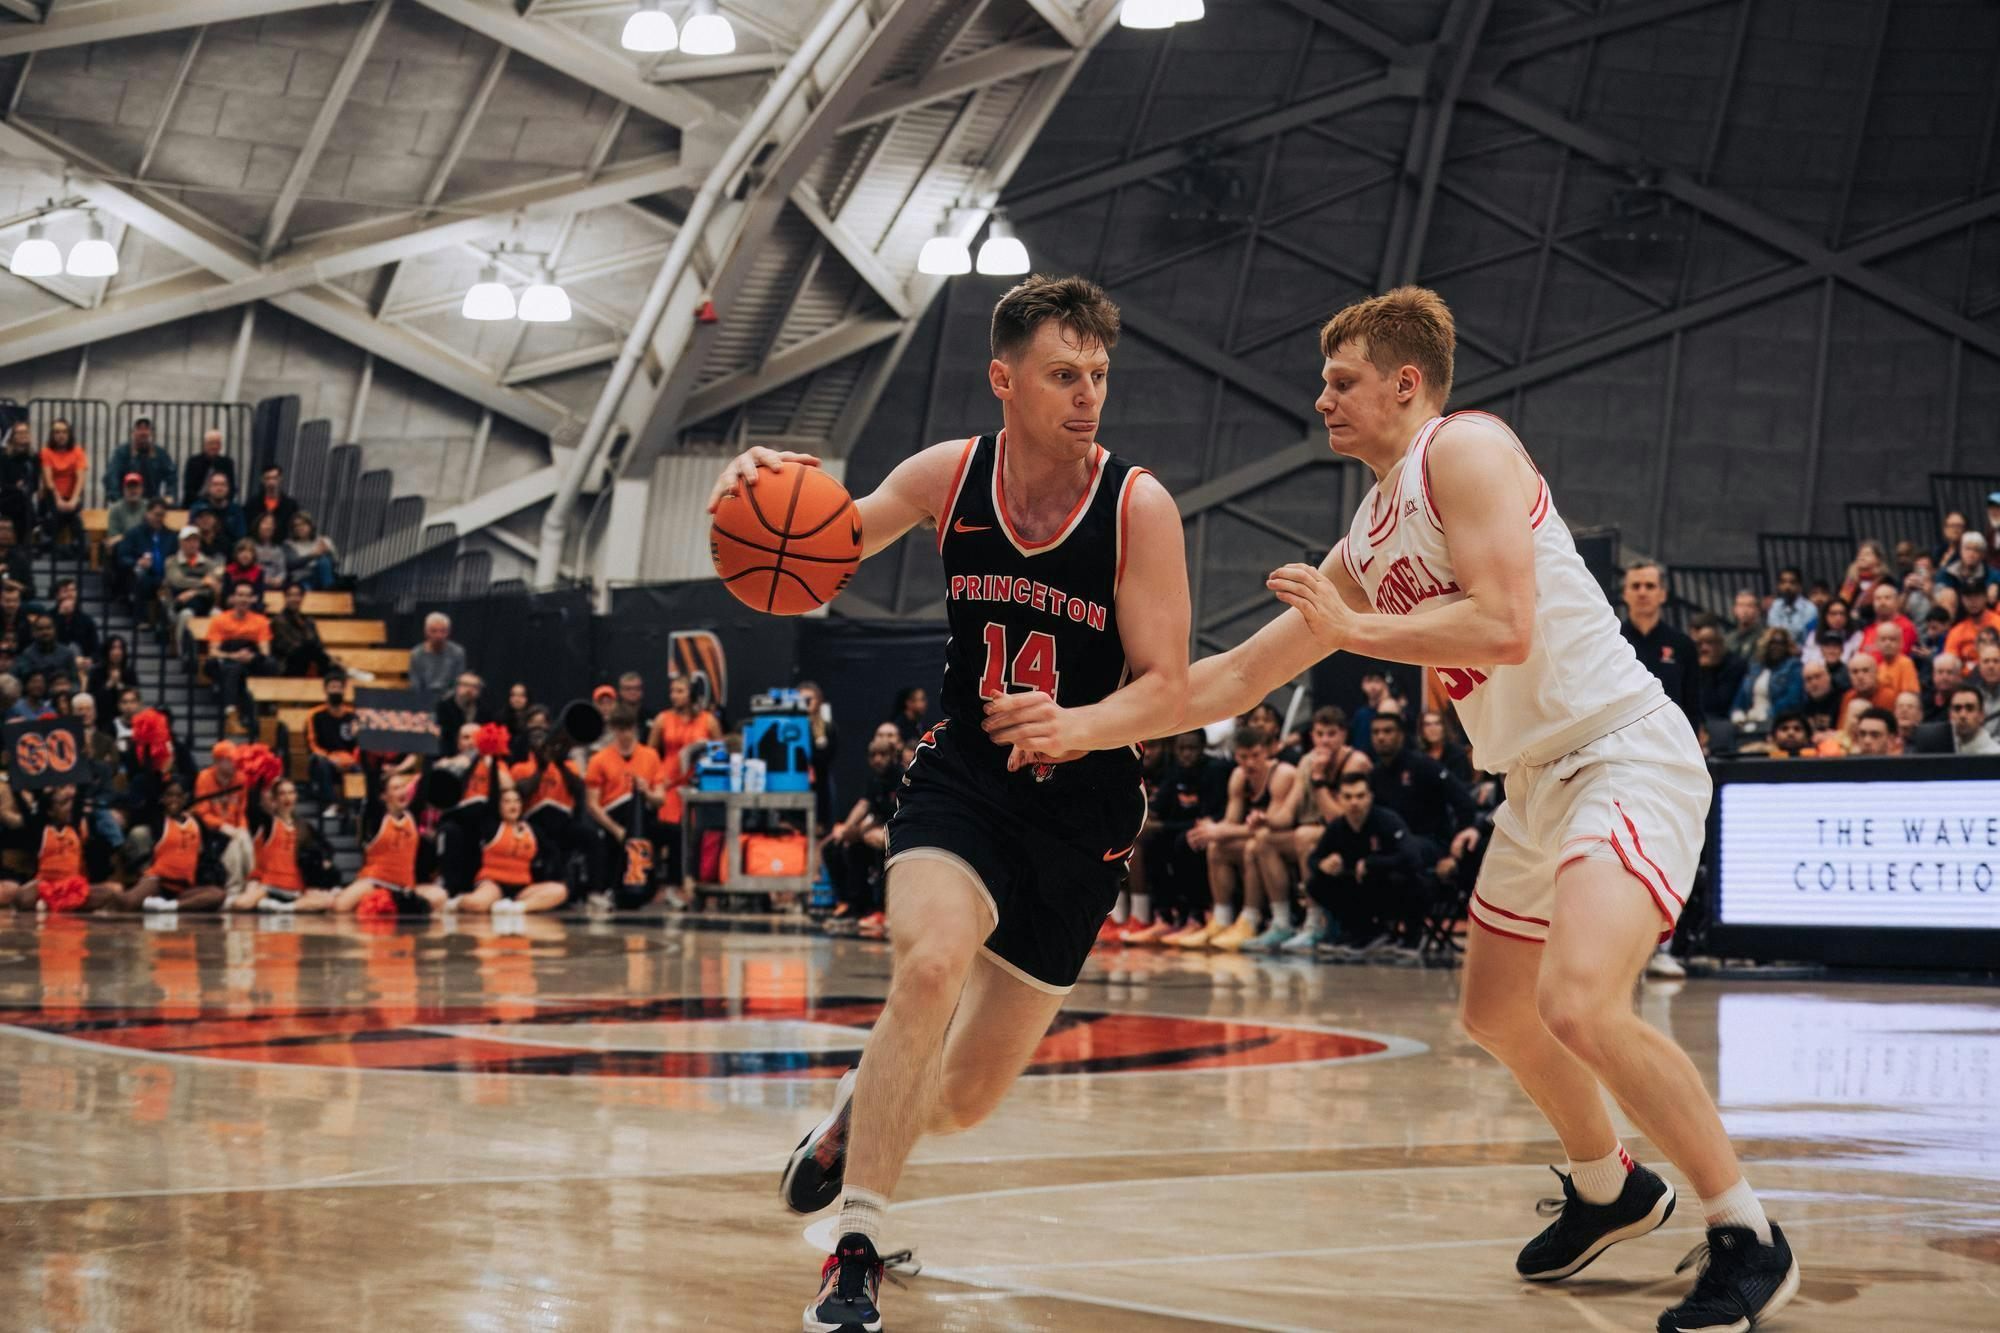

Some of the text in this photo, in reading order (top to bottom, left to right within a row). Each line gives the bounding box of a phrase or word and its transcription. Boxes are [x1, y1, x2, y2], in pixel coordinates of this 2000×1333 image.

[951, 575, 1107, 632] PRINCETON
[1376, 555, 1461, 615] ORNELL
[979, 621, 1060, 701] 14
[1817, 818, 1998, 846] THE WAVE
[1794, 861, 1993, 892] COLLECTIO
